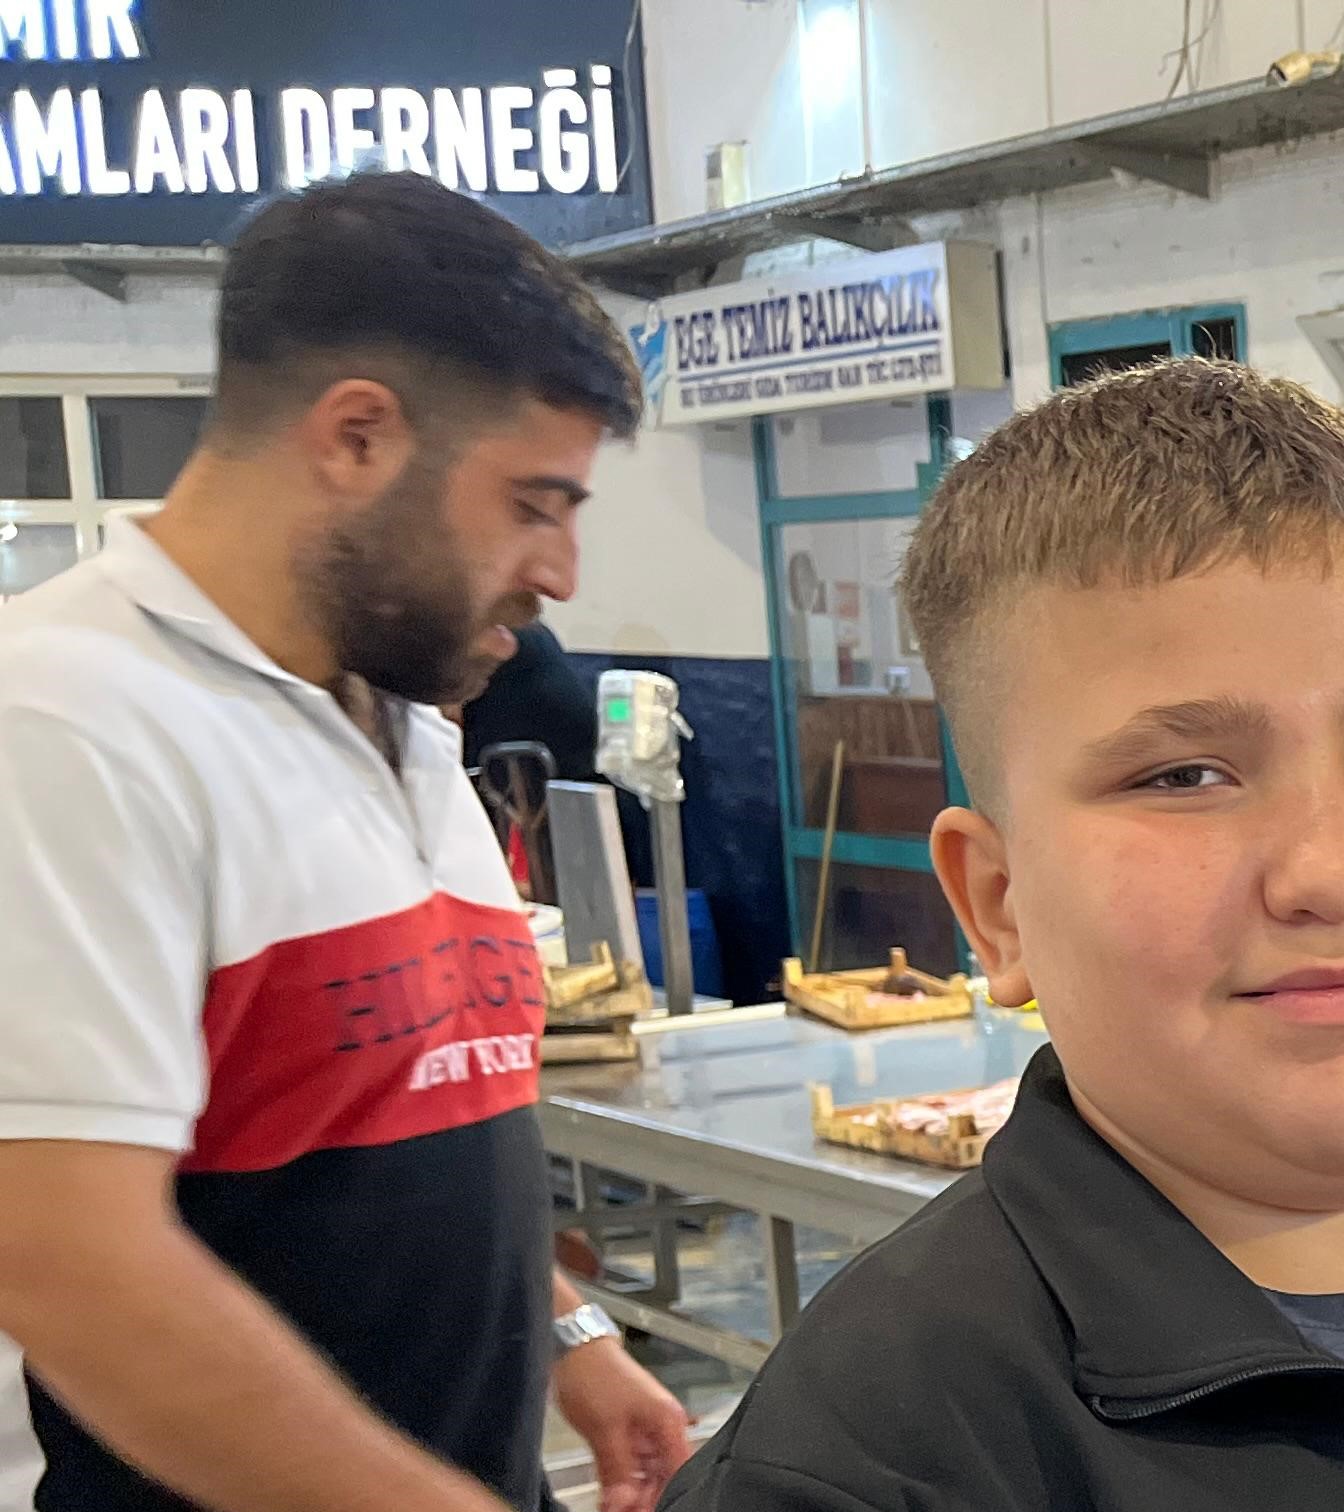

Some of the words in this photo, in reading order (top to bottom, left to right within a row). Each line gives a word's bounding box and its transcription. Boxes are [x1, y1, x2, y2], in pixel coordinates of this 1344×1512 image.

[675, 310, 719, 370] EGE
[721, 287, 793, 364] TEMİZ
[796, 268, 942, 352] BALIKÇILIK
